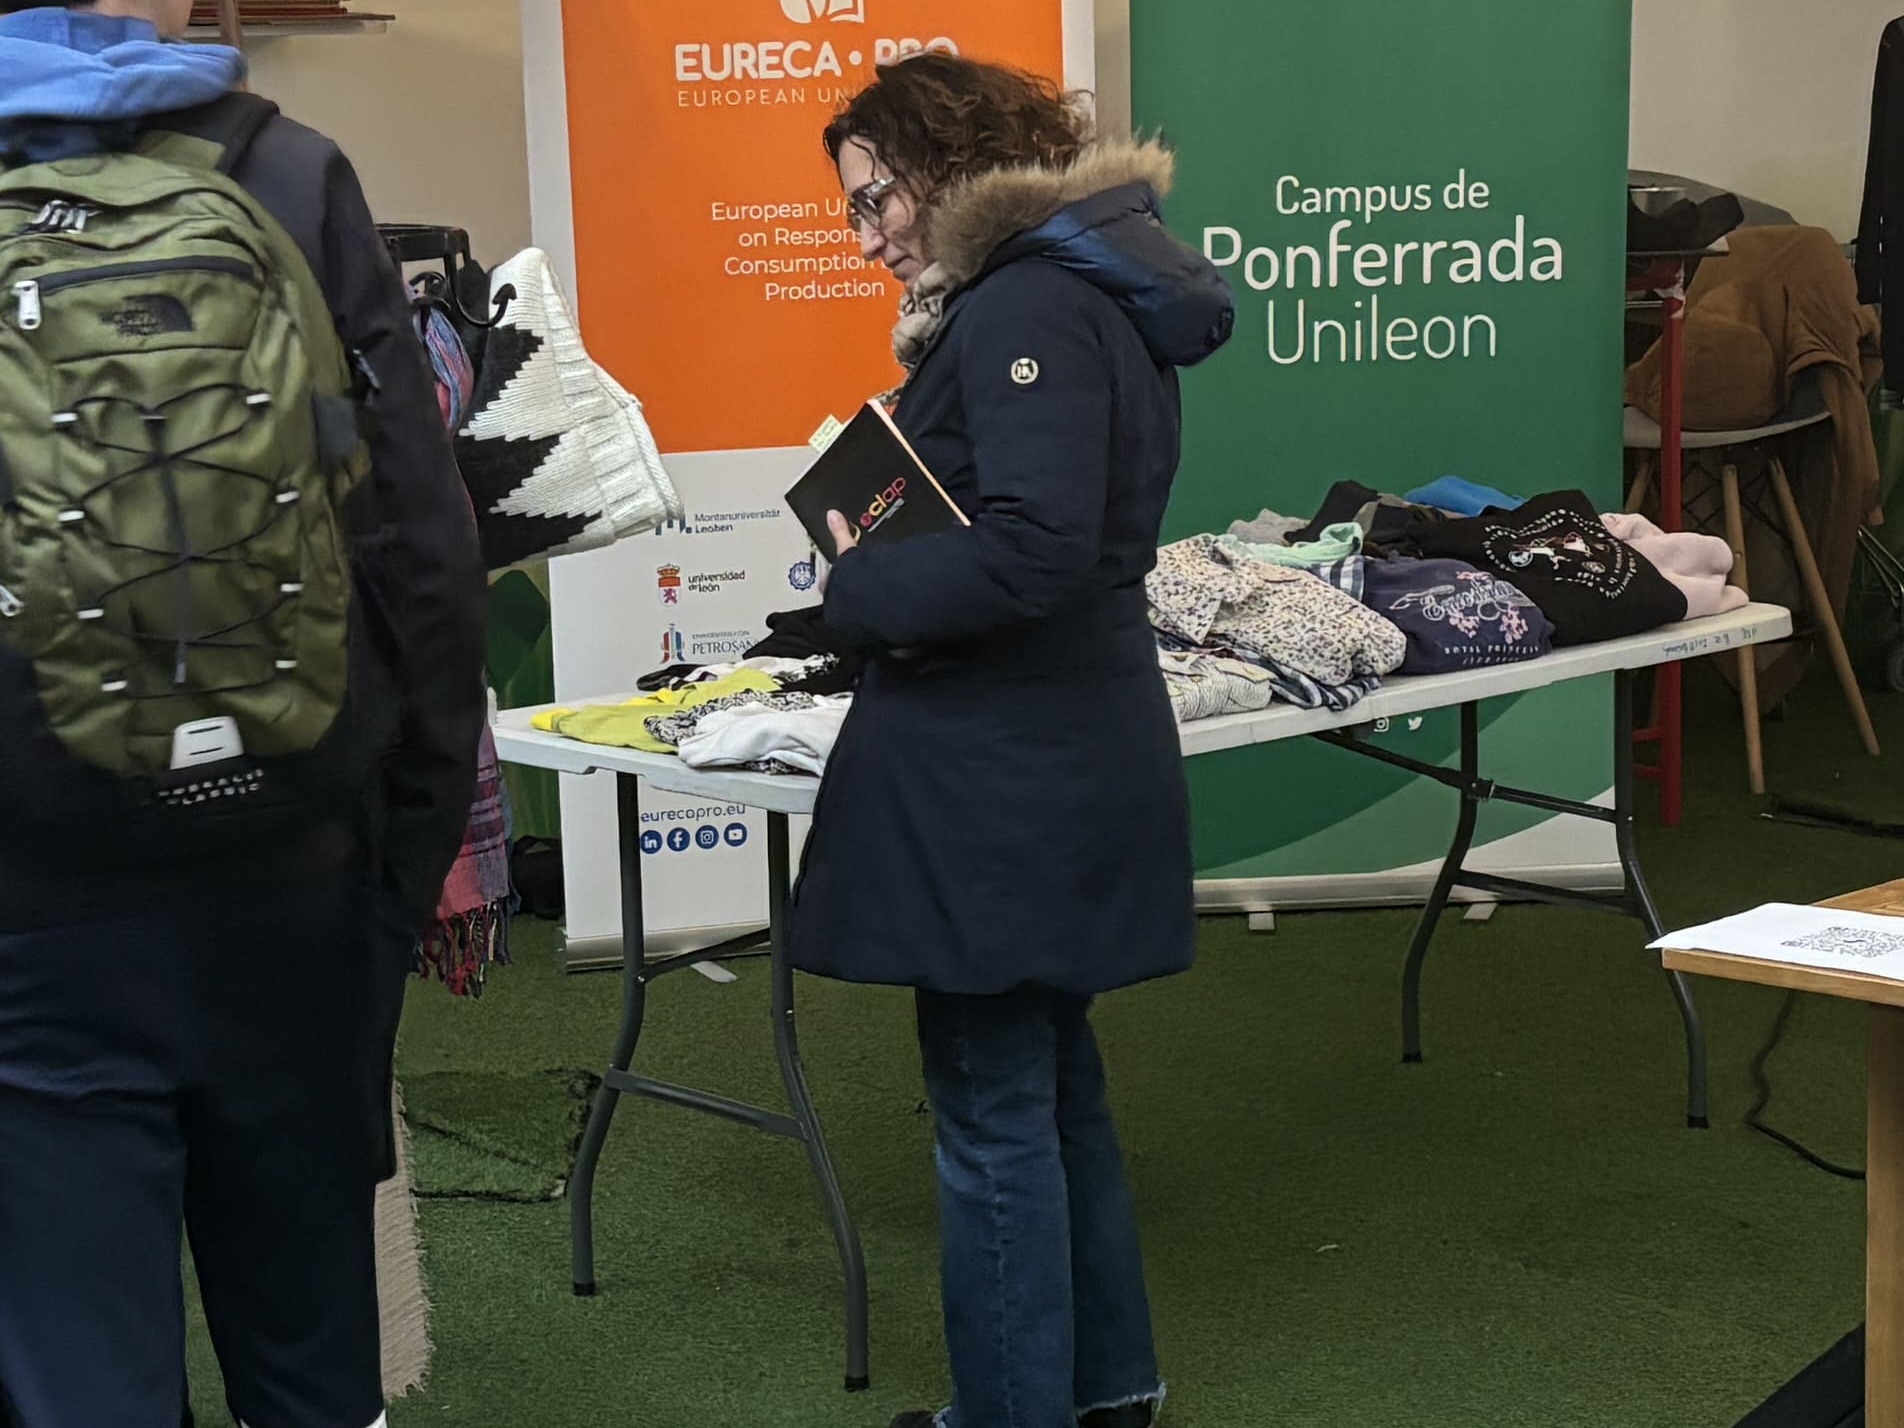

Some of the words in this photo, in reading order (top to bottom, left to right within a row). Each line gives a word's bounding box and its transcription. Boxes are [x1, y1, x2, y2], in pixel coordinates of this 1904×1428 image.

[675, 41, 842, 81] EURECA
[678, 88, 806, 107] EUROPEAN
[1276, 174, 1432, 224] Campus
[1443, 168, 1490, 210] de
[711, 202, 818, 222] European
[738, 232, 767, 247] on
[1204, 214, 1562, 290] Ponferrada
[765, 279, 884, 300] Production
[1268, 294, 1496, 364] Unileon
[688, 570, 746, 584] universidad
